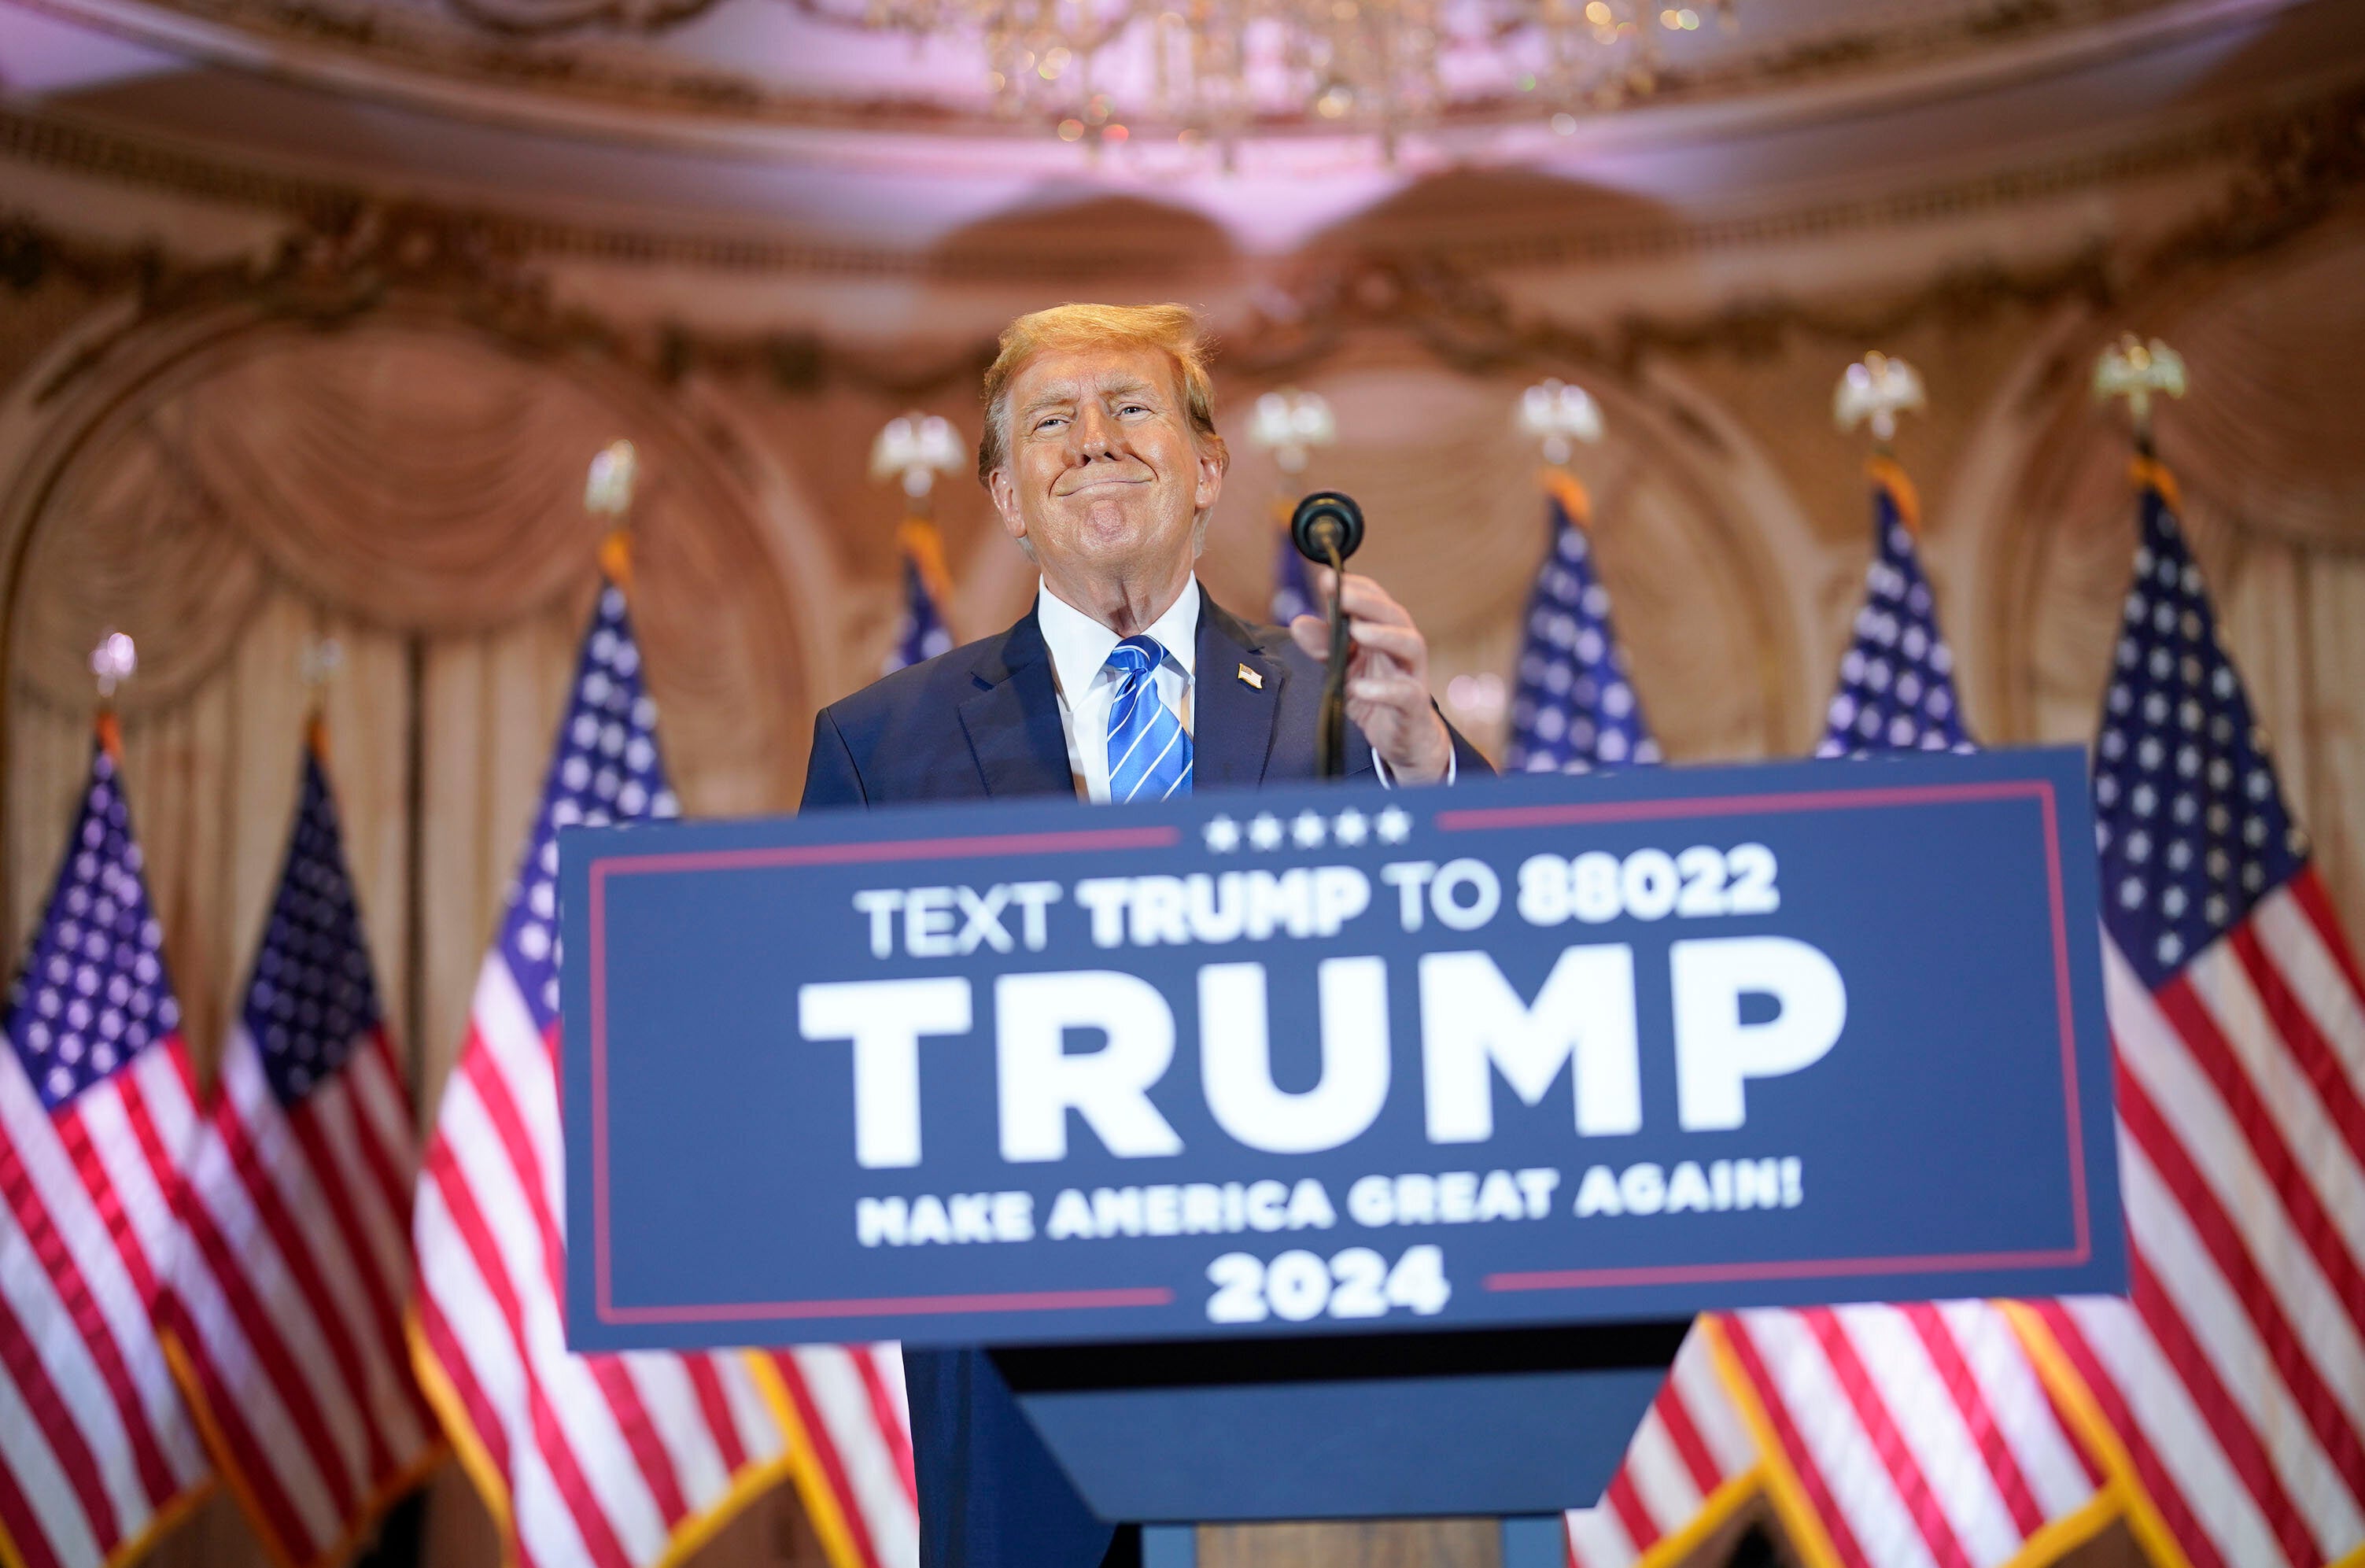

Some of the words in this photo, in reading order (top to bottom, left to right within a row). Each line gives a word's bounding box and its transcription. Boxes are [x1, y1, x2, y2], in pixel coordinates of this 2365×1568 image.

[856, 881, 1060, 957] TEXT
[1076, 866, 1371, 947] TRUMP
[1385, 859, 1500, 929] TO
[1518, 844, 1780, 925] 88022
[799, 937, 1847, 1168] TRUMP
[856, 1192, 1034, 1246] MAKE
[1048, 1179, 1334, 1239] AMERICA
[1348, 1168, 1559, 1227] GREAT
[1575, 1157, 1802, 1216] AGAIN!
[1207, 1245, 1450, 1323] 2024
